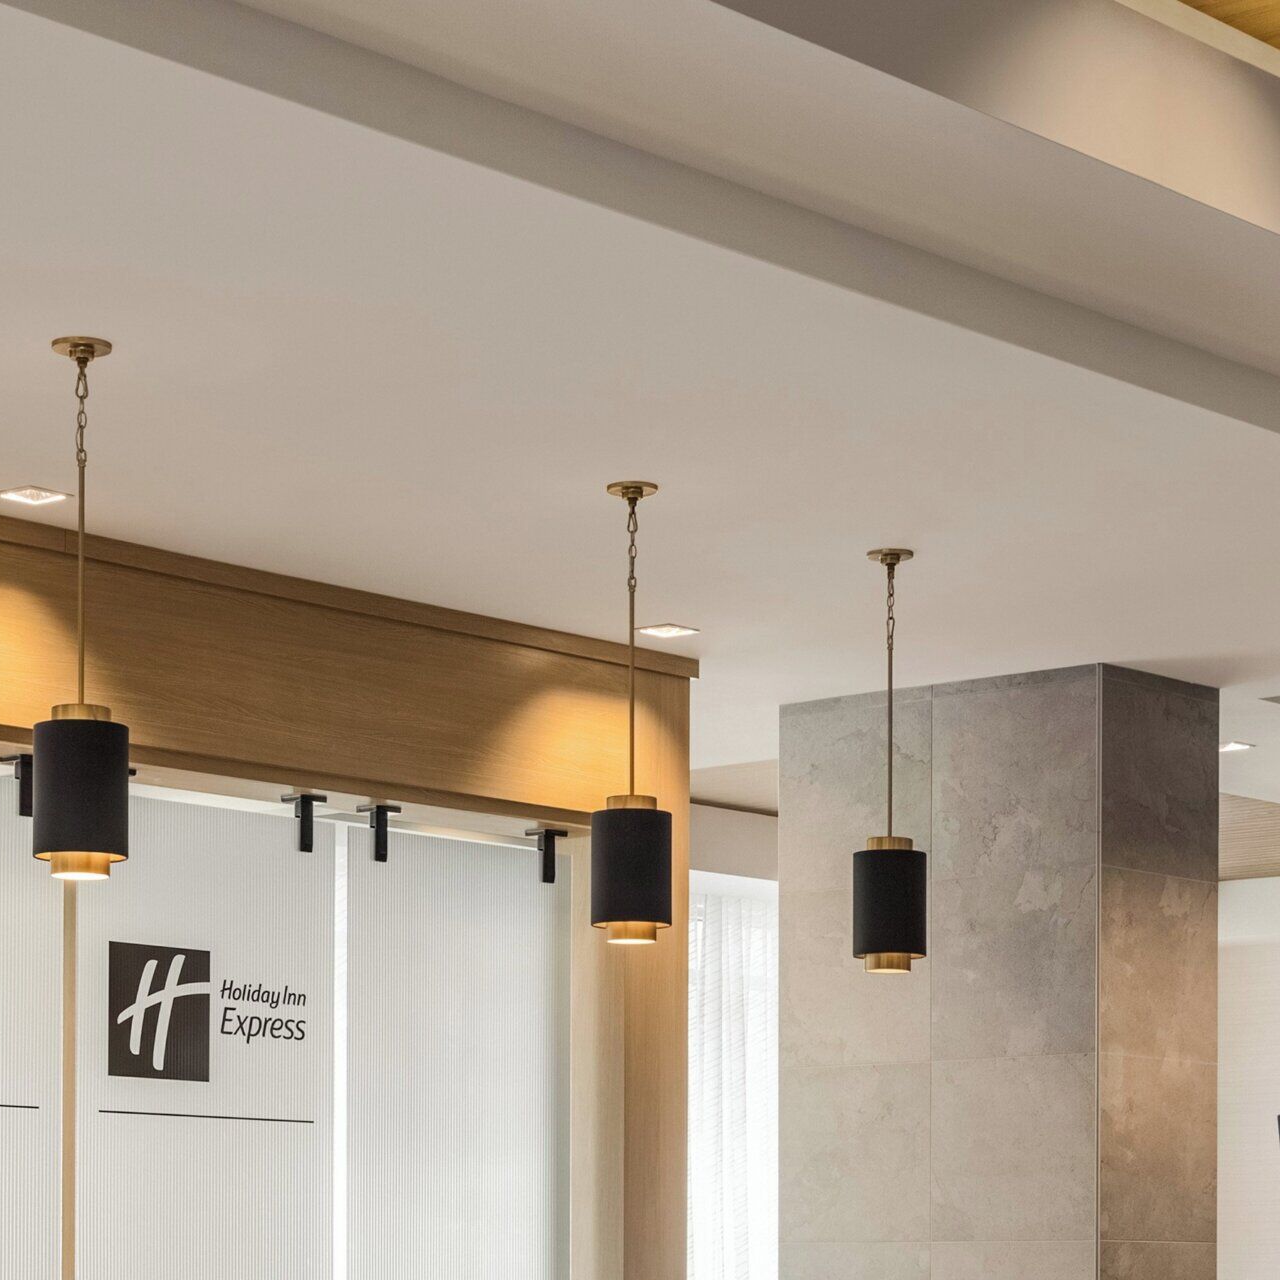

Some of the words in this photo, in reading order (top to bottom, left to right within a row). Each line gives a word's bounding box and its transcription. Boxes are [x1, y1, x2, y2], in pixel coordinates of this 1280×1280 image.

[220, 979, 281, 1009] Holiday
[282, 985, 307, 1007] Inn
[220, 1006, 306, 1044] Express
